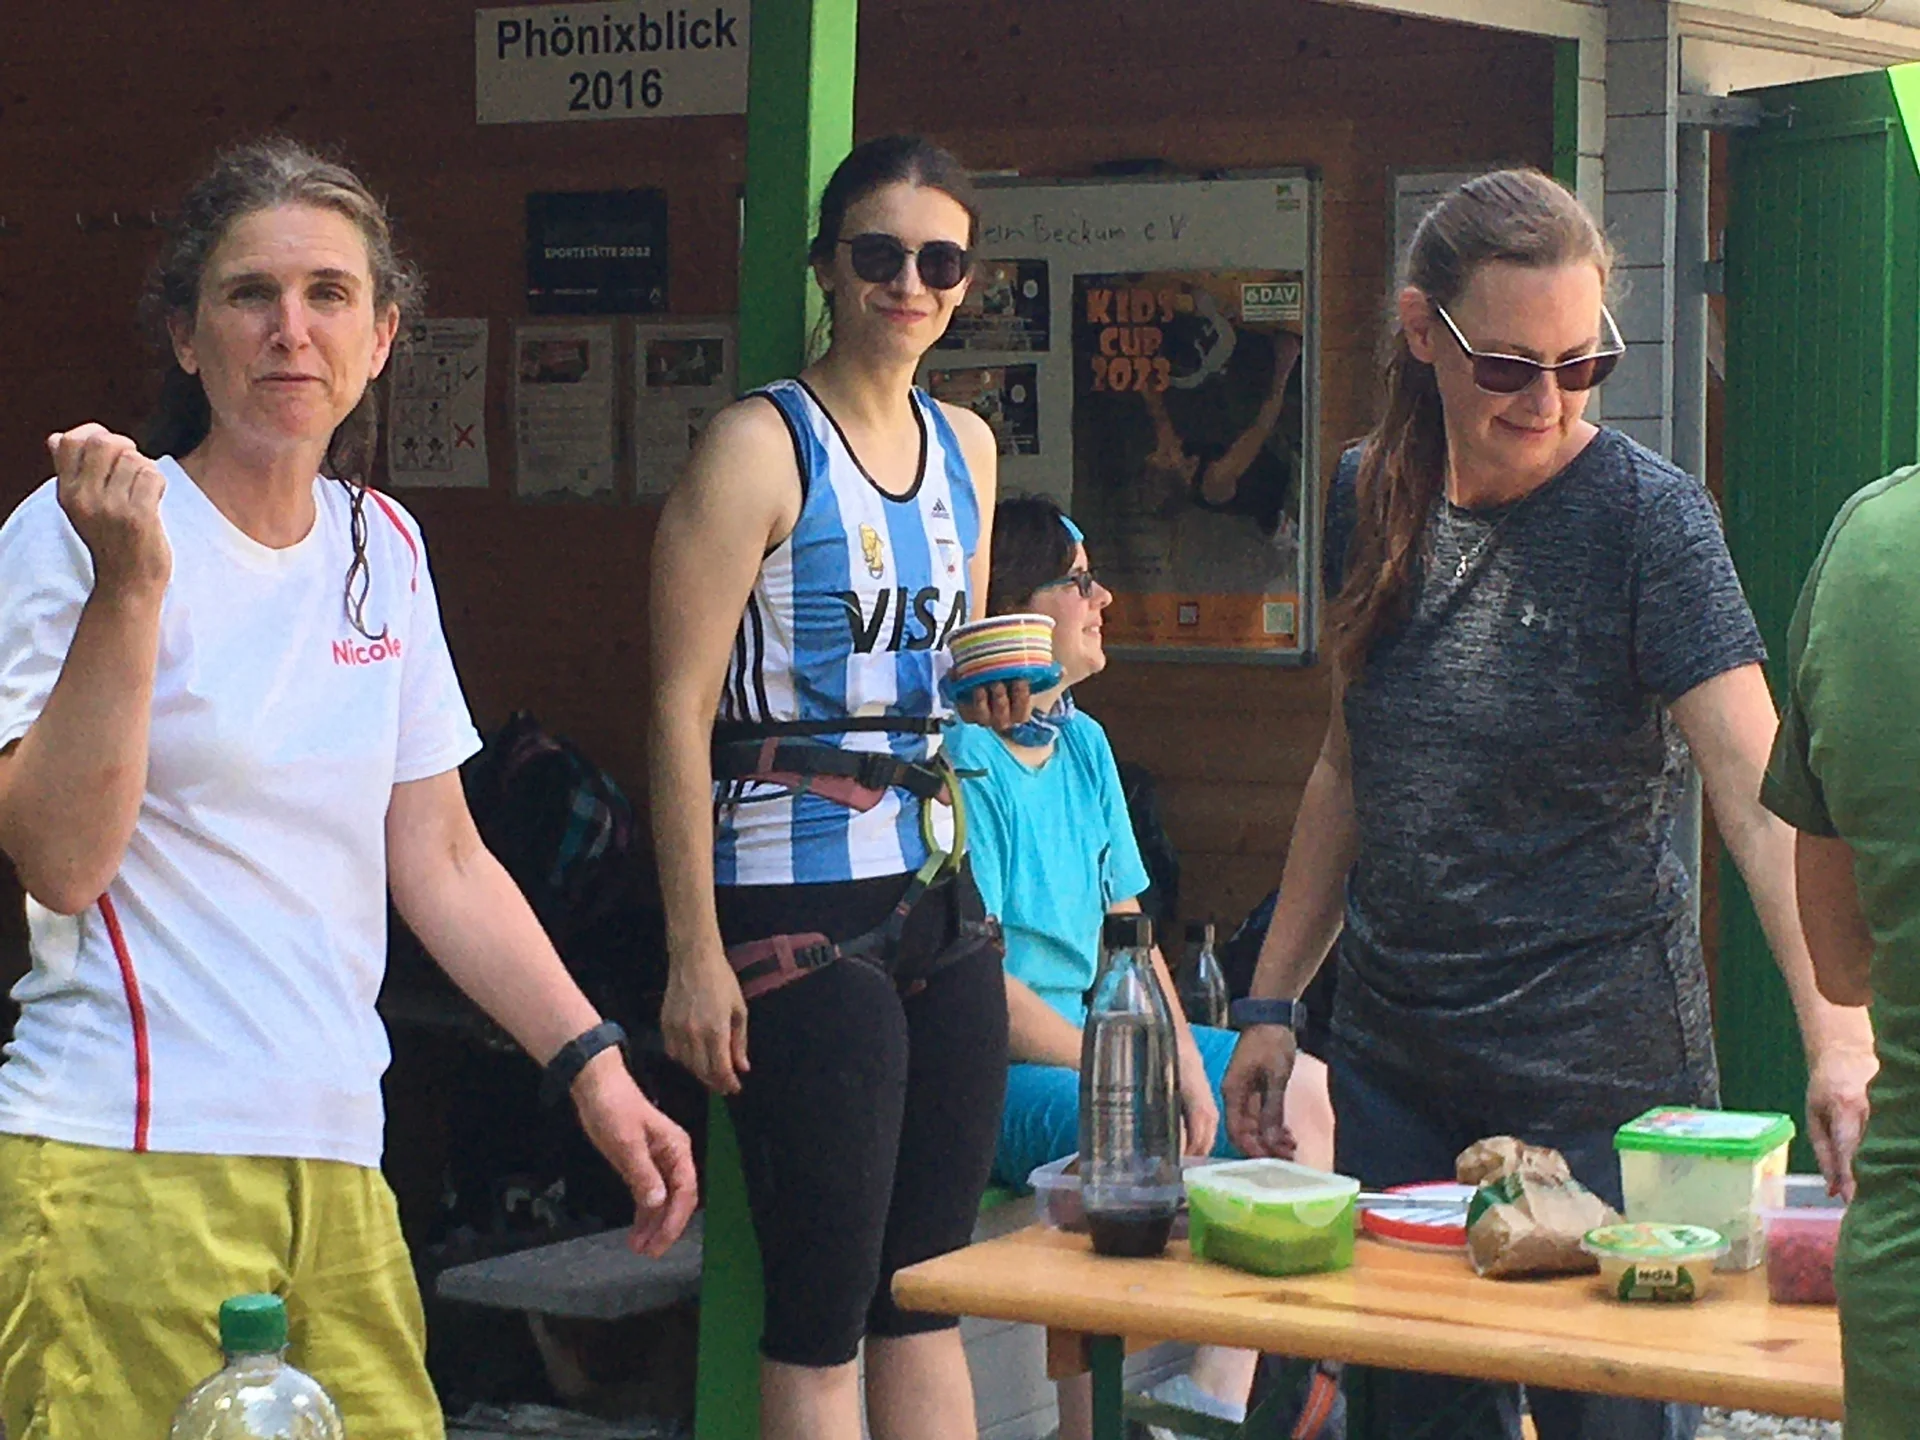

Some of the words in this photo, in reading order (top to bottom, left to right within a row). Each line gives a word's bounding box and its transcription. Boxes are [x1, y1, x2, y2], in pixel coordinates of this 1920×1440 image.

[498, 8, 737, 59] Phönixblick
[569, 68, 663, 111] 2016
[1086, 288, 1174, 323] KIDS
[1260, 287, 1297, 303] DAV
[1100, 327, 1163, 356] CUP
[838, 586, 967, 655] VISA
[332, 637, 402, 666] Nicole
